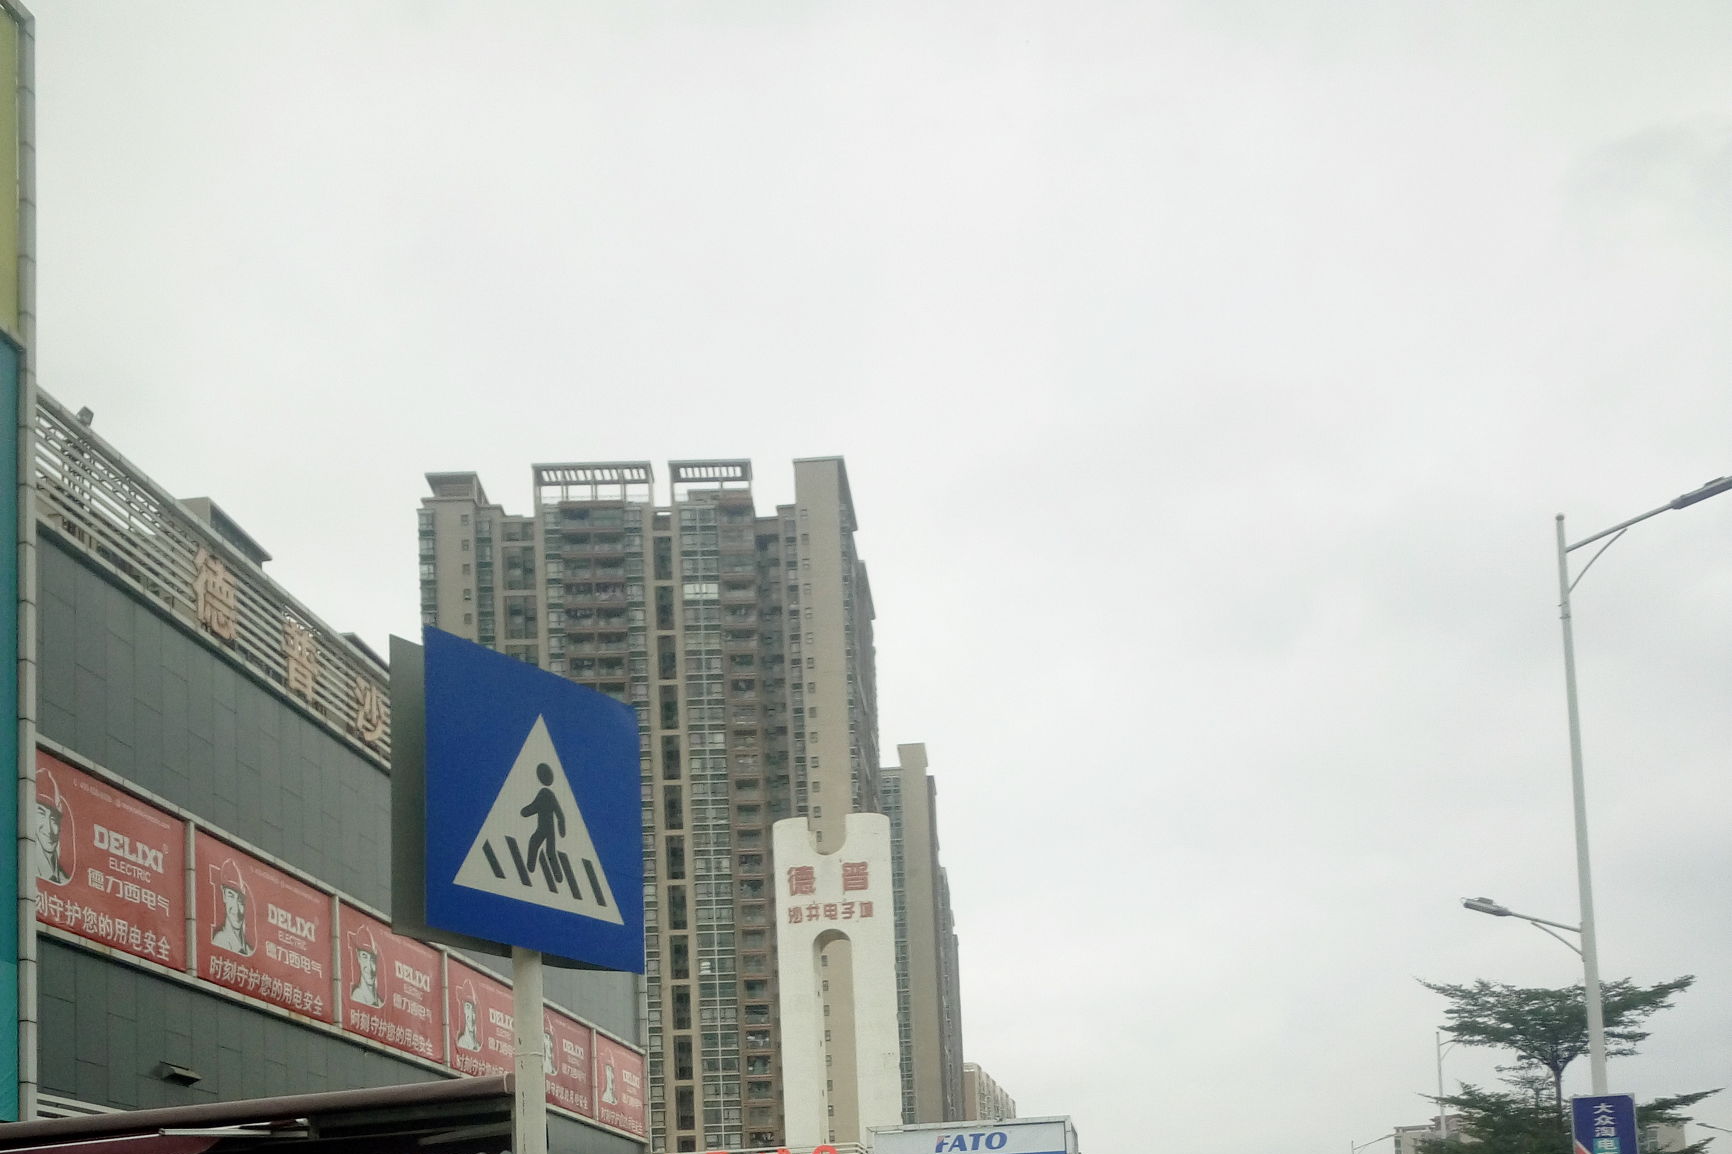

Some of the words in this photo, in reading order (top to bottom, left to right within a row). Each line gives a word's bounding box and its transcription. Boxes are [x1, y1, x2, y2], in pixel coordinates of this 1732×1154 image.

[93, 823, 164, 874] DELIXI
[109, 857, 151, 883] ELECTRIC
[87, 868, 170, 917] 德力西电气
[36, 891, 171, 962] 刻守护您的用电安全
[267, 903, 316, 942] DELIXI
[209, 955, 324, 1016] 时刻守护您的用电安全
[935, 1131, 1008, 1154] FATO
